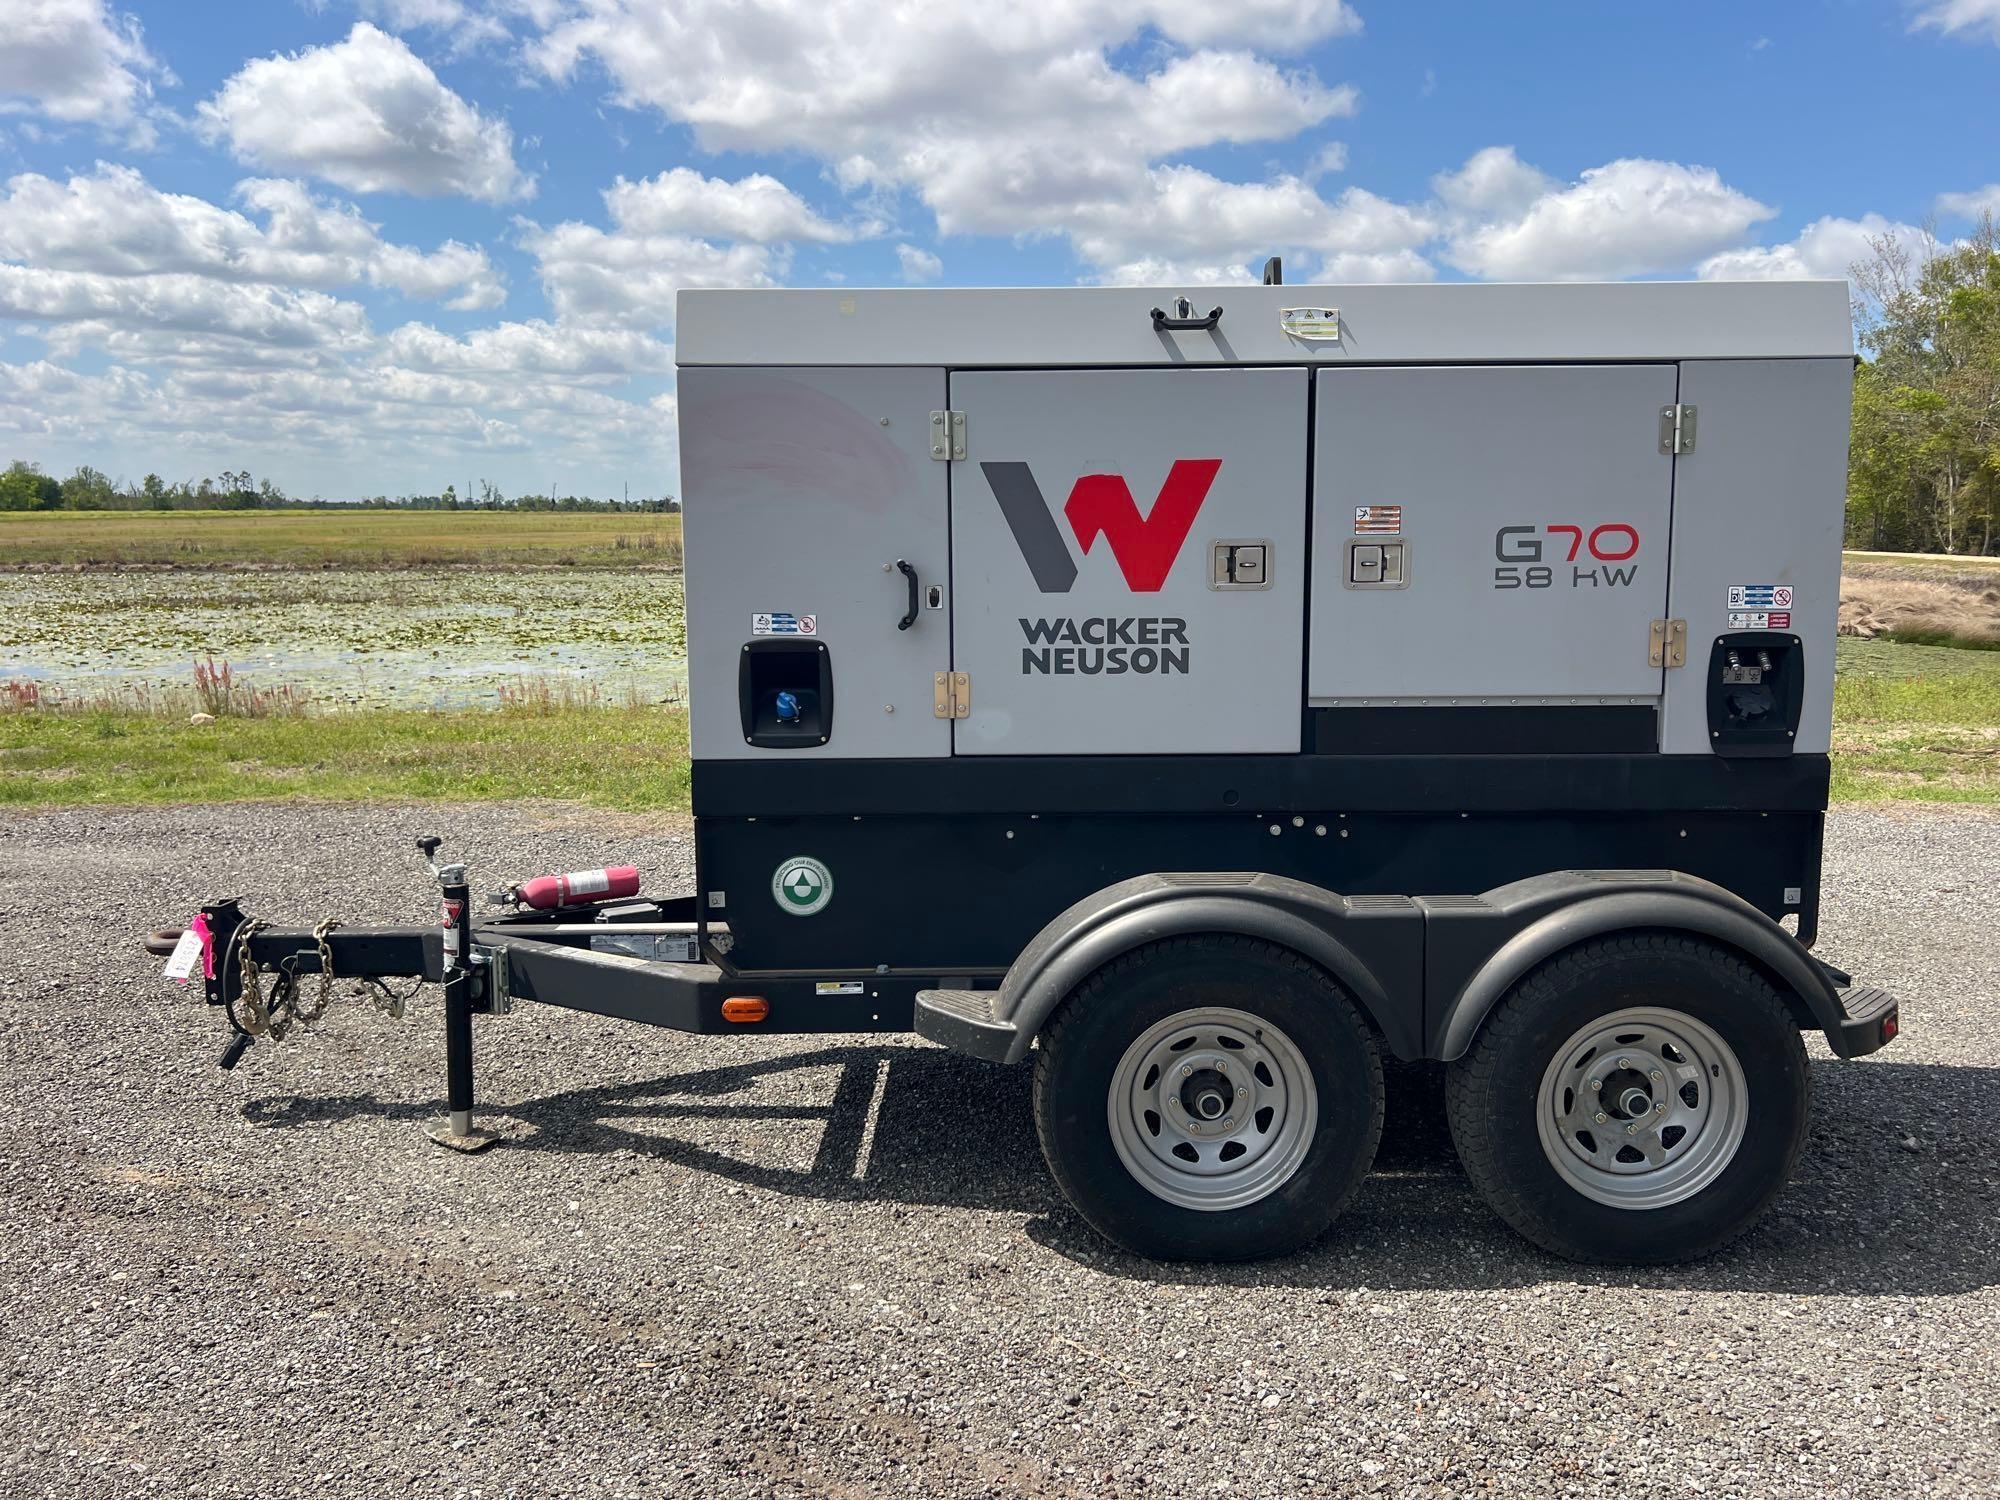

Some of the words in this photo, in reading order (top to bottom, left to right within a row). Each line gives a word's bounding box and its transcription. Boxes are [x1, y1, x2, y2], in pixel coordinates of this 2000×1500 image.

[1496, 524, 1640, 562] G70
[1494, 566, 1553, 589] 58
[1018, 617, 1190, 645] WACKER
[1022, 647, 1190, 675] NEUSON
[775, 862, 794, 889] PROTECTING
[806, 860, 830, 889] ENVIRONMENT
